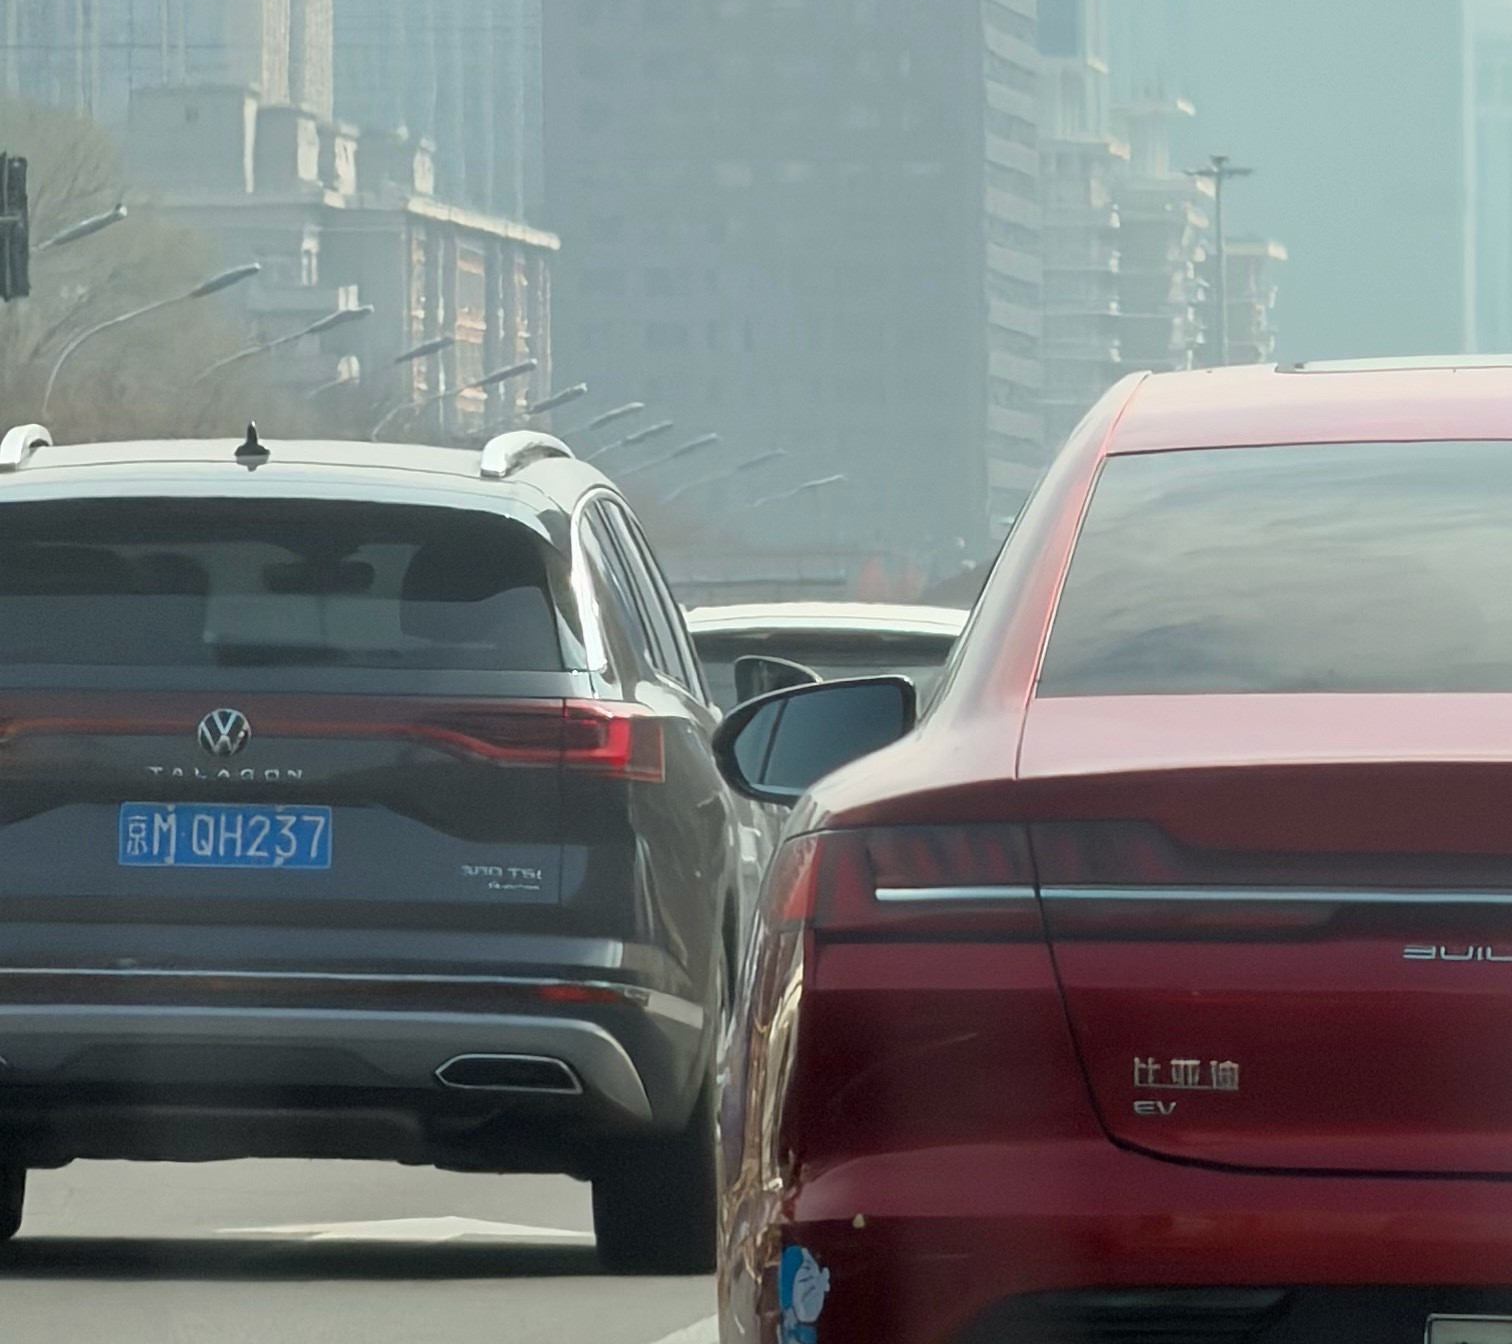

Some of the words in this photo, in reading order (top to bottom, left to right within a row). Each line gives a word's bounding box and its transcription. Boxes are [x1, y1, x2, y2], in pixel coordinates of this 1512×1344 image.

[147, 766, 304, 781] TALAGON
[1133, 1057, 1240, 1090] 比亚迪
[1133, 1100, 1177, 1115] EV
